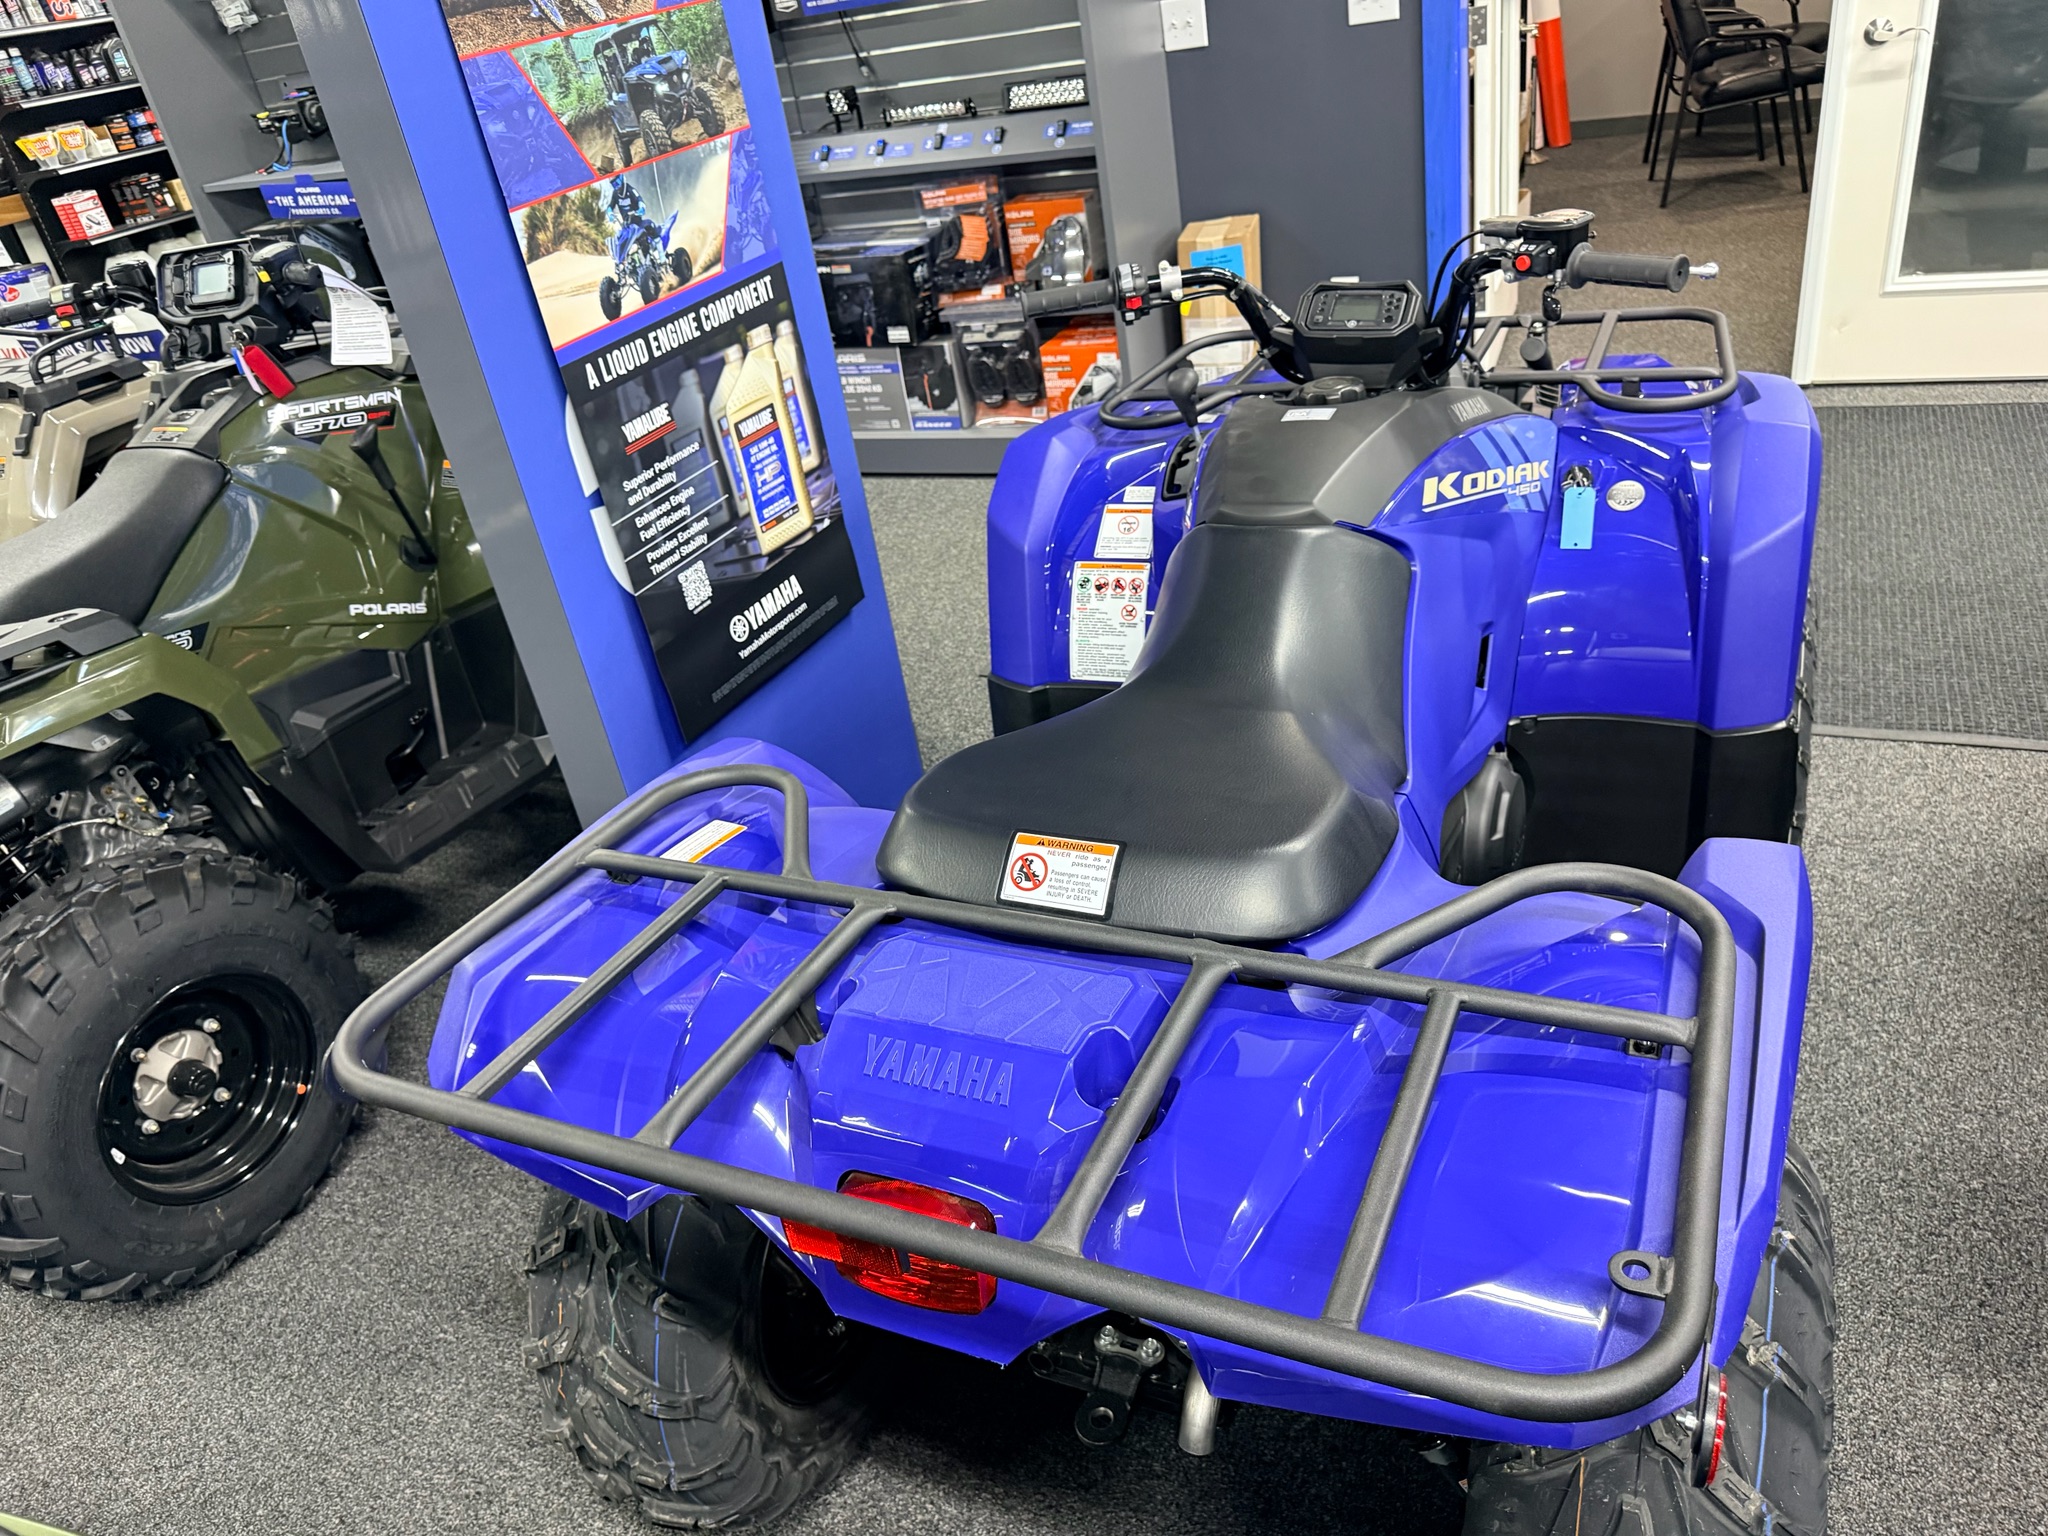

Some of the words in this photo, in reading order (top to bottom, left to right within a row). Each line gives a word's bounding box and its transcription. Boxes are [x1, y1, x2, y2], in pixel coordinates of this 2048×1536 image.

[275, 195, 296, 207] THE
[297, 194, 350, 206] AMERICAN
[585, 362, 600, 390] A
[598, 338, 650, 383] LIQUID
[648, 312, 701, 359] ENGINE
[699, 275, 775, 332] COMPONENT
[266, 388, 402, 424] SPORTSMAN
[294, 411, 368, 435] 570
[621, 402, 671, 443] YAMALUBE
[738, 407, 774, 438] YAMALUBE
[1450, 397, 1491, 422] YAMAHA
[622, 467, 655, 492] Superior
[653, 441, 700, 474] Performance
[1422, 460, 1550, 506] KODIAK
[627, 488, 644, 506] and
[642, 470, 677, 497] Durability
[1507, 482, 1541, 497] 450
[634, 501, 671, 528] Enhances
[669, 486, 695, 507] Engine
[639, 524, 657, 542] Fuel
[656, 504, 691, 531] Efficiency
[646, 537, 678, 563] Provides
[677, 516, 709, 543] Excellent
[649, 549, 681, 575] Thermal
[680, 533, 708, 556] Stability
[349, 602, 428, 616] POLARIS
[744, 574, 803, 631] YAMAHA
[738, 602, 808, 660] YamahaMotorsports.com
[1047, 839, 1094, 853] WARNING
[1047, 850, 1071, 858] NEVER
[1050, 869, 1079, 879] Passengers
[1080, 873, 1089, 881] can
[1091, 875, 1106, 883] cause
[1071, 861, 1108, 871] passenger.
[1046, 890, 1064, 899] INJURY
[1047, 883, 1069, 893] resulting
[1077, 887, 1098, 896] SEVERE
[862, 1033, 1014, 1108] YAMAHA
